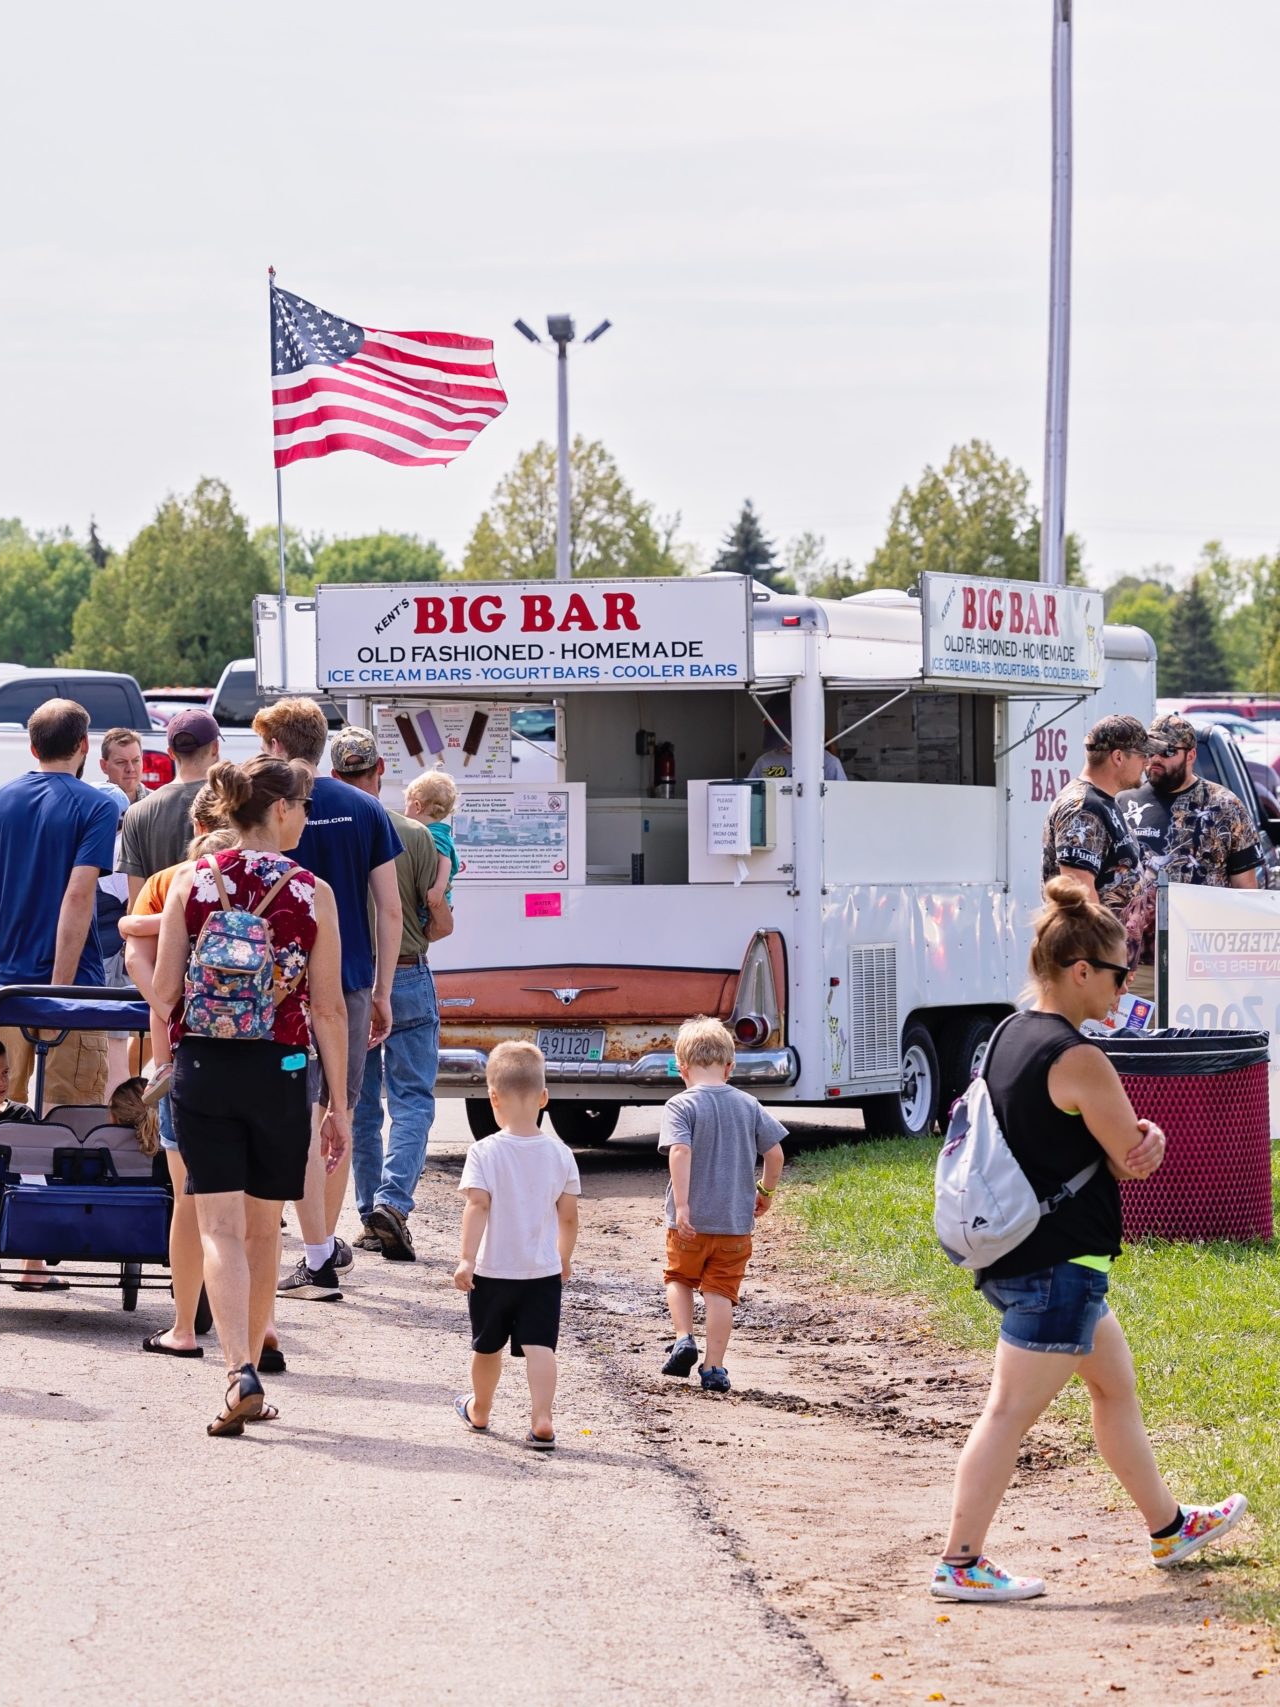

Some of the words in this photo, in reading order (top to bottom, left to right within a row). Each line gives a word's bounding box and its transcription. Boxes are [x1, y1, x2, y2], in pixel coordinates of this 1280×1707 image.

[374, 597, 410, 635] KENT'S
[413, 594, 507, 635] BIG
[520, 592, 641, 633] BAR
[962, 586, 1004, 632] BIG
[1009, 591, 1060, 638] BAR
[357, 646, 406, 664] OLD
[411, 643, 545, 663] FASHIONED
[560, 640, 704, 660] HOMEMADE
[944, 635, 964, 653] OLD
[966, 636, 1018, 658] FASHIONED
[1023, 643, 1076, 663] HOMEMADE
[327, 669, 355, 683] ICE
[359, 668, 421, 682] CREAM
[425, 667, 472, 681] BARS
[553, 666, 600, 680] BARS
[612, 665, 684, 679] COOLER
[689, 663, 738, 678] BARS
[932, 657, 944, 671] ICE
[945, 658, 971, 674] CREAM
[971, 660, 991, 675] BARS
[1043, 666, 1071, 680] COOLER
[1071, 669, 1089, 682] BARS
[1035, 728, 1068, 761] BIG
[551, 1037, 590, 1055] 91120
